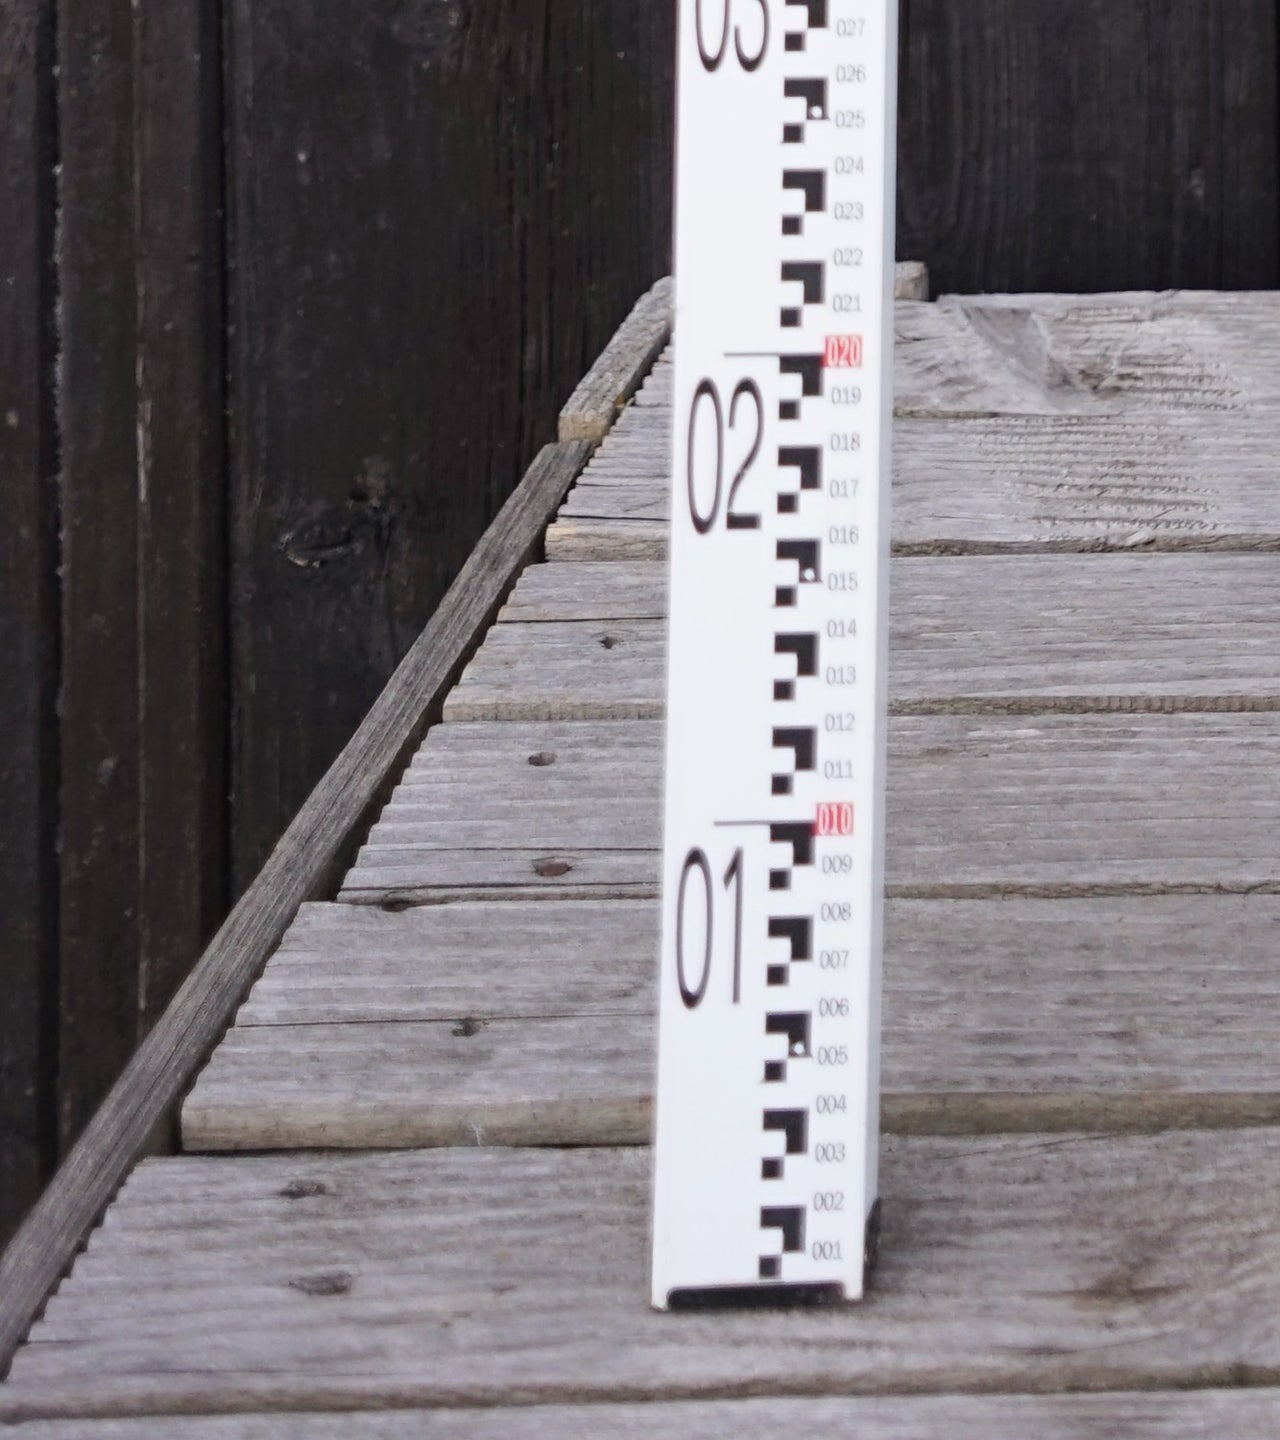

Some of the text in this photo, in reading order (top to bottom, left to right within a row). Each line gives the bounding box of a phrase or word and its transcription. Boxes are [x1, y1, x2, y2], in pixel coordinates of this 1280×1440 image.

[835, 18, 866, 38] 027
[835, 63, 867, 83] 026
[834, 109, 866, 129] 025
[833, 155, 865, 176] 024
[833, 201, 865, 221] 023
[832, 247, 864, 267] 022
[831, 293, 862, 314] 021
[826, 336, 861, 366] 020
[830, 385, 862, 406] 019
[829, 431, 861, 452] 018
[687, 377, 764, 534] 02
[828, 478, 860, 499] 017
[828, 525, 860, 545] 016
[827, 571, 859, 592] 015
[826, 618, 858, 639] 014
[825, 665, 857, 686] 013
[824, 712, 856, 733] 012
[823, 759, 854, 780] 011
[817, 805, 853, 834] 010
[821, 854, 853, 875] 009
[820, 902, 852, 922] 008
[676, 846, 744, 1008] 01
[819, 949, 850, 970] 007
[818, 997, 850, 1018] 006
[816, 1045, 849, 1066] 005
[815, 1094, 847, 1115] 004
[814, 1142, 846, 1163] 003
[812, 1191, 845, 1212] 002
[811, 1240, 843, 1261] 001
